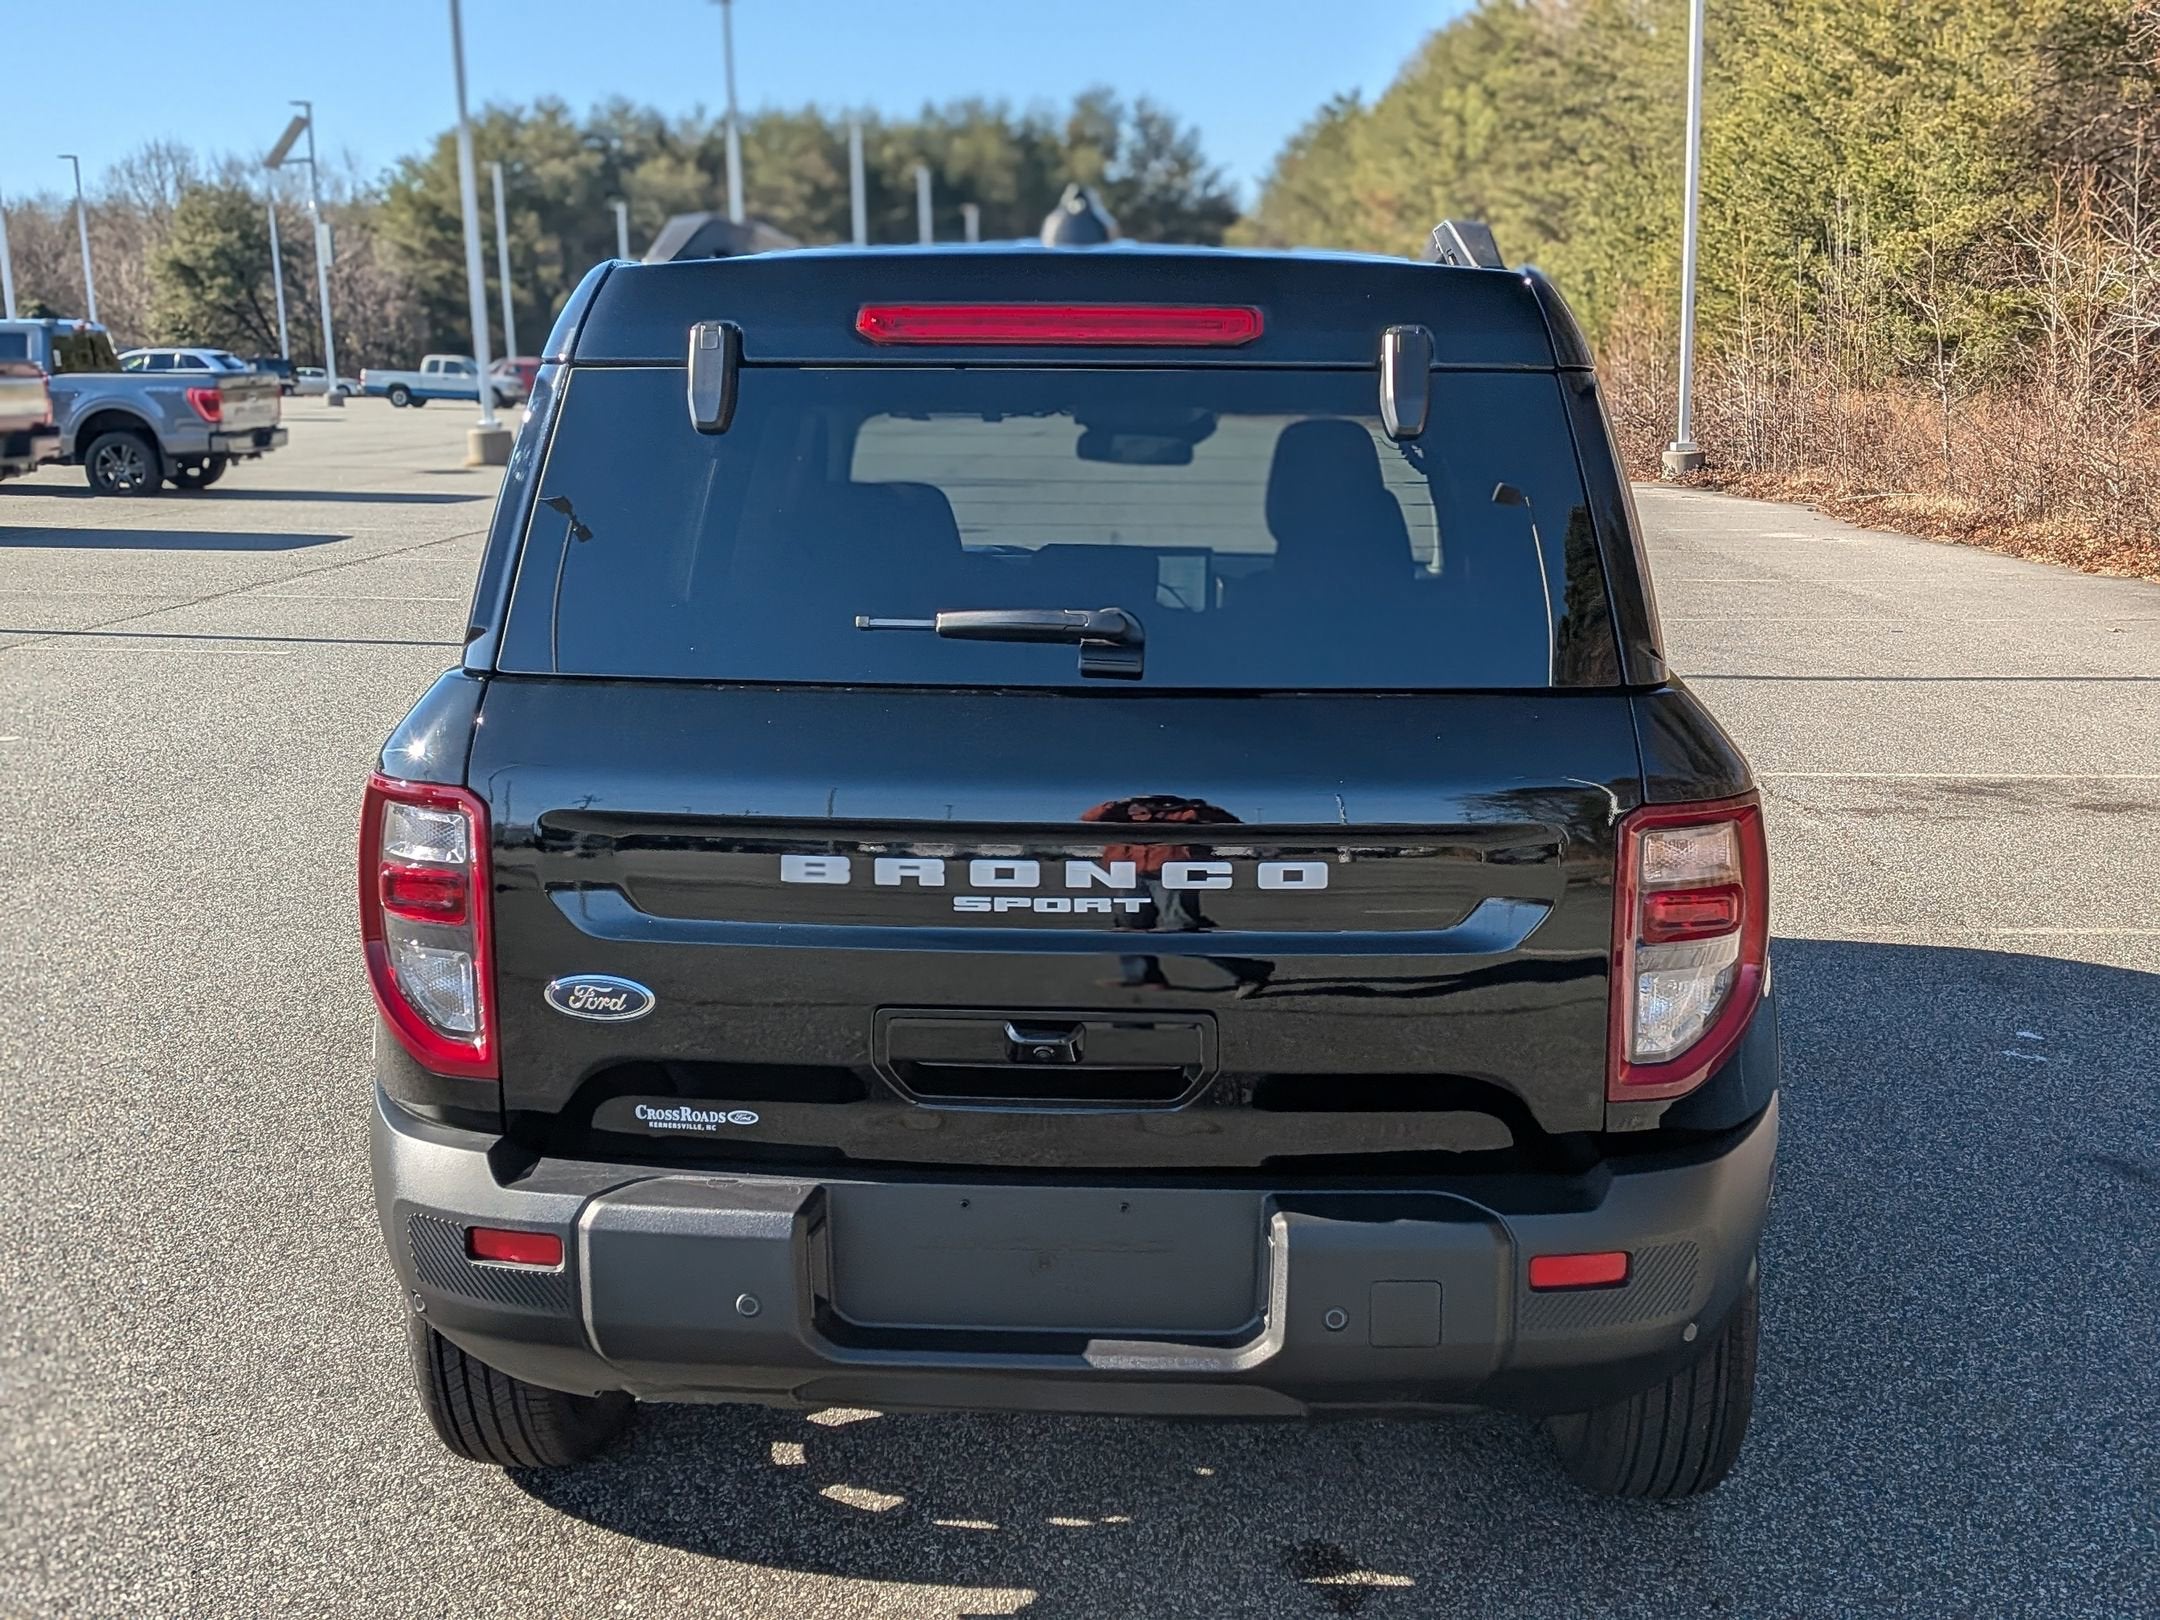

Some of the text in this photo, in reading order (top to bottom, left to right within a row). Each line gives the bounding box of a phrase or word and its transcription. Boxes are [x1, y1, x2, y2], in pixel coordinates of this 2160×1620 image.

[780, 854, 1329, 890] BRONCO
[953, 896, 1151, 913] SPORT
[568, 984, 627, 1012] Ford
